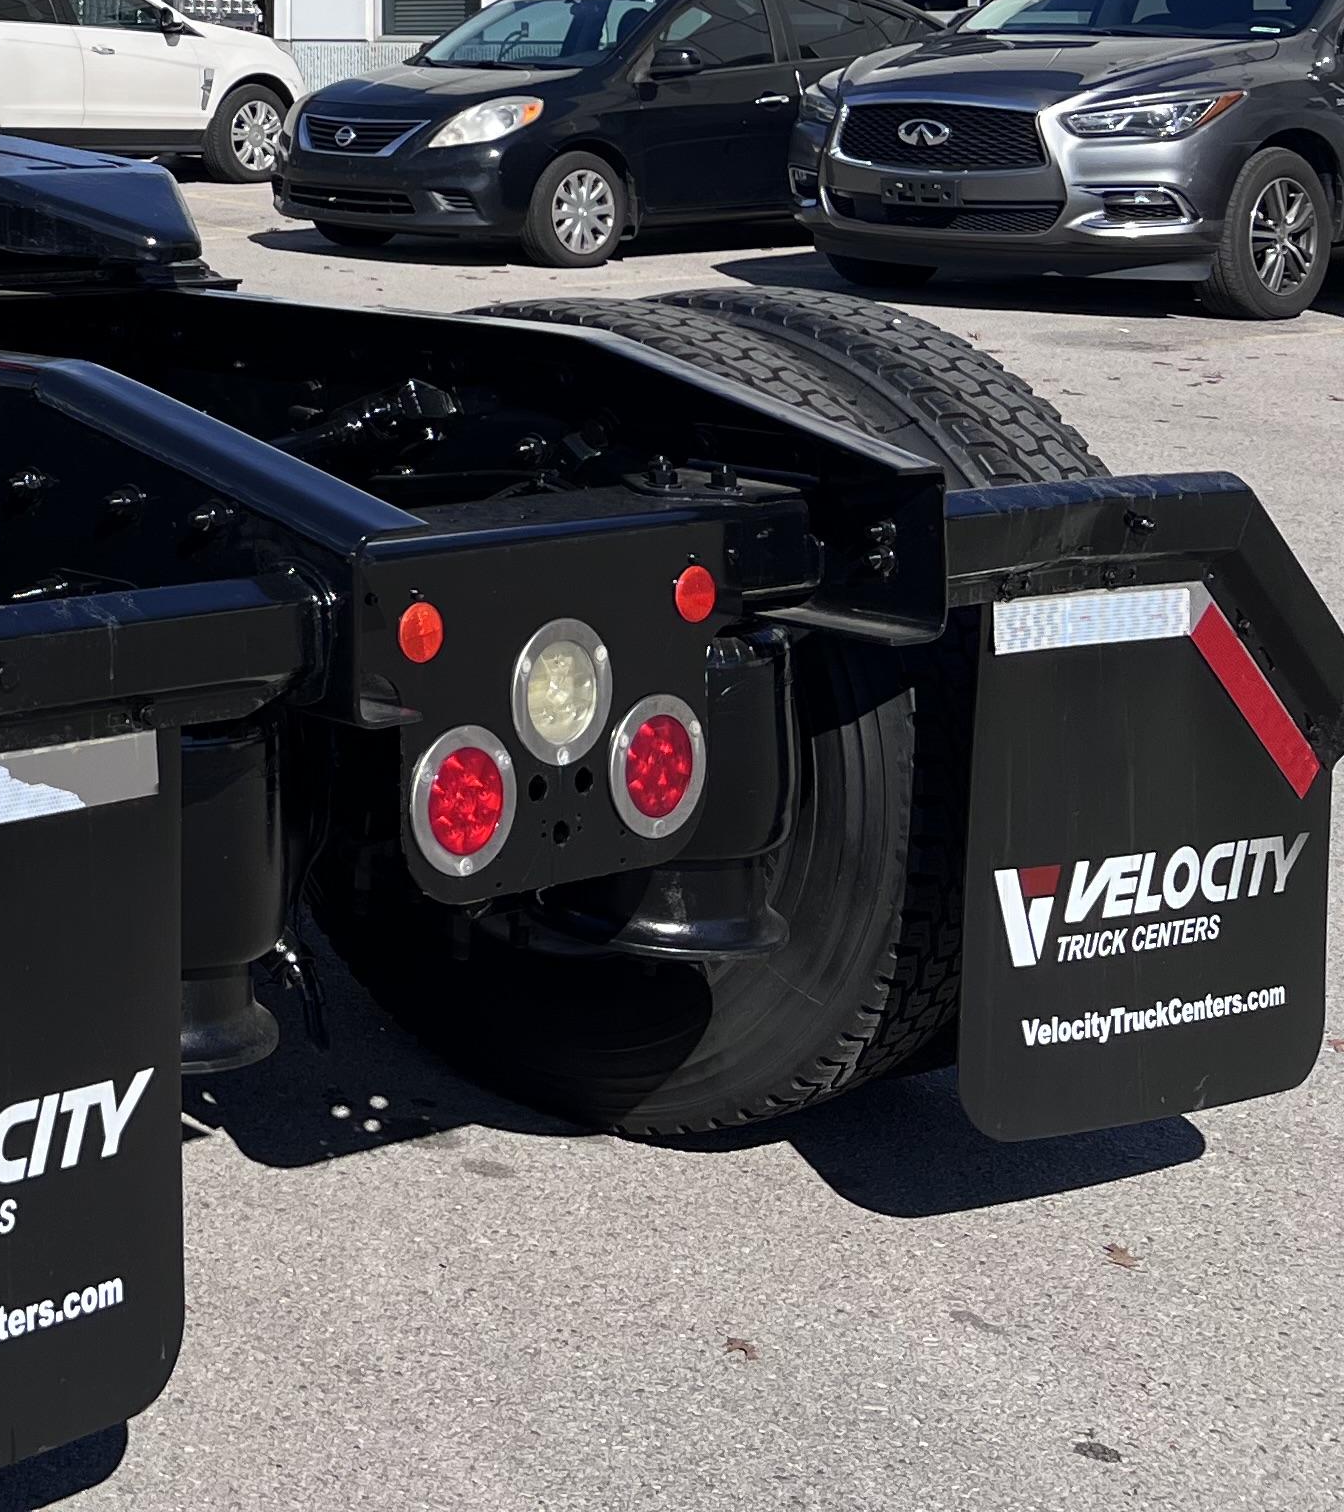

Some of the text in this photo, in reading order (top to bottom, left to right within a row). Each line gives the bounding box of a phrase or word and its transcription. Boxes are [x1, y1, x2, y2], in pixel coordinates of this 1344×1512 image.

[1064, 832, 1310, 924] VELOCITY
[1056, 914, 1221, 963] TRUCK CENTERS
[1021, 985, 1286, 1047] VelocityTruckCenters.com
